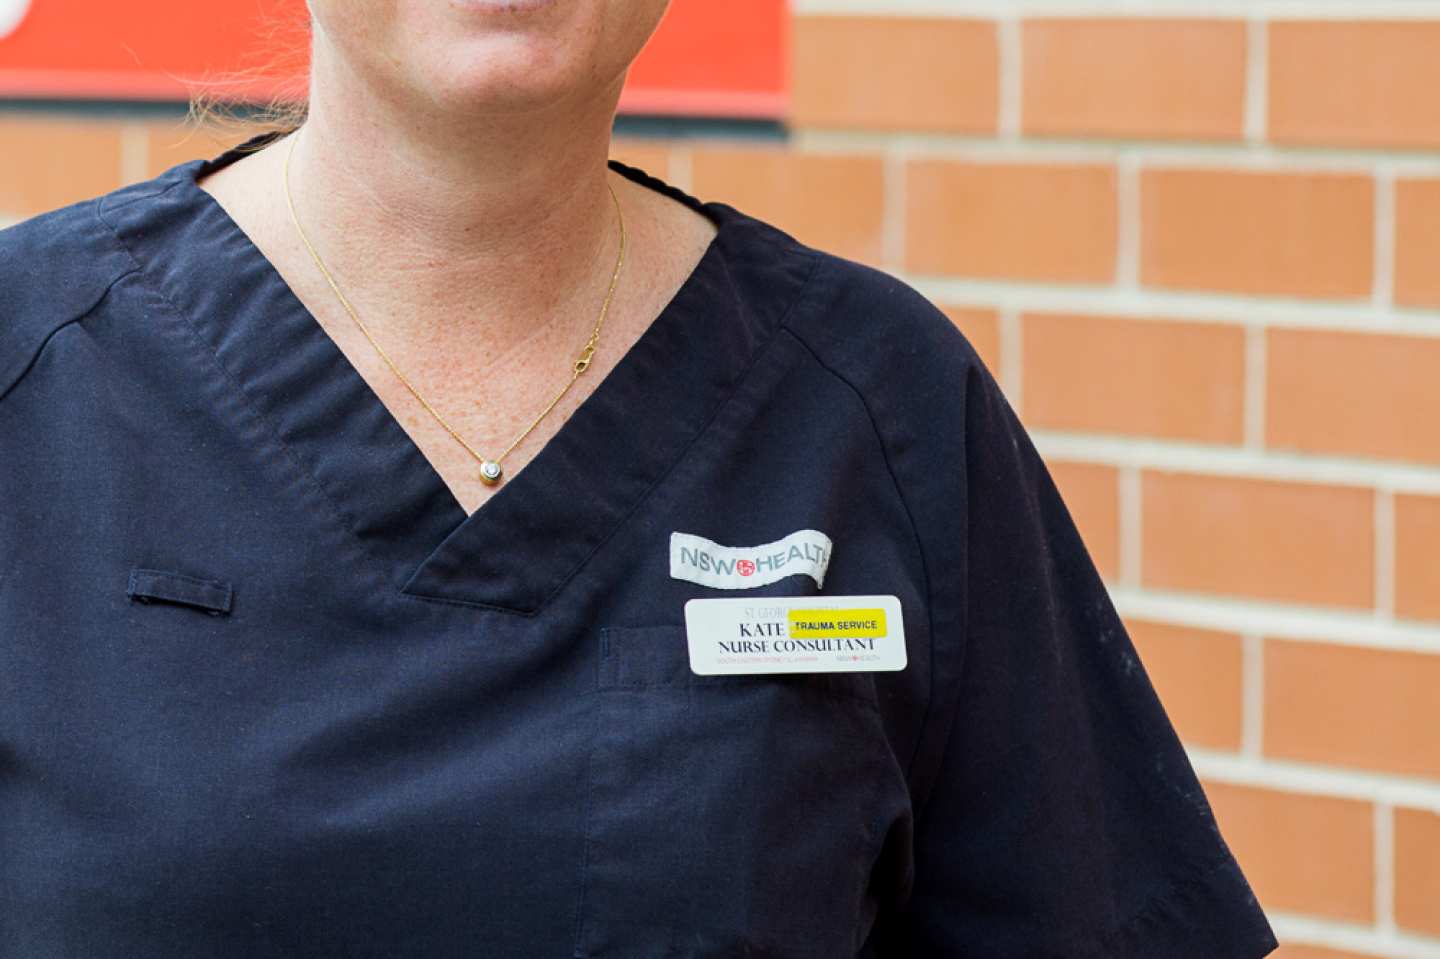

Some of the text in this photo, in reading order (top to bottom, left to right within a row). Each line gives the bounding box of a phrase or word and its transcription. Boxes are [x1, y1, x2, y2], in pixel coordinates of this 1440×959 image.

[680, 546, 736, 575] NSW
[739, 622, 785, 638] KATE
[795, 620, 878, 631] TRAUMA SERVICE
[718, 637, 876, 655] NURSE CONSULTANT
